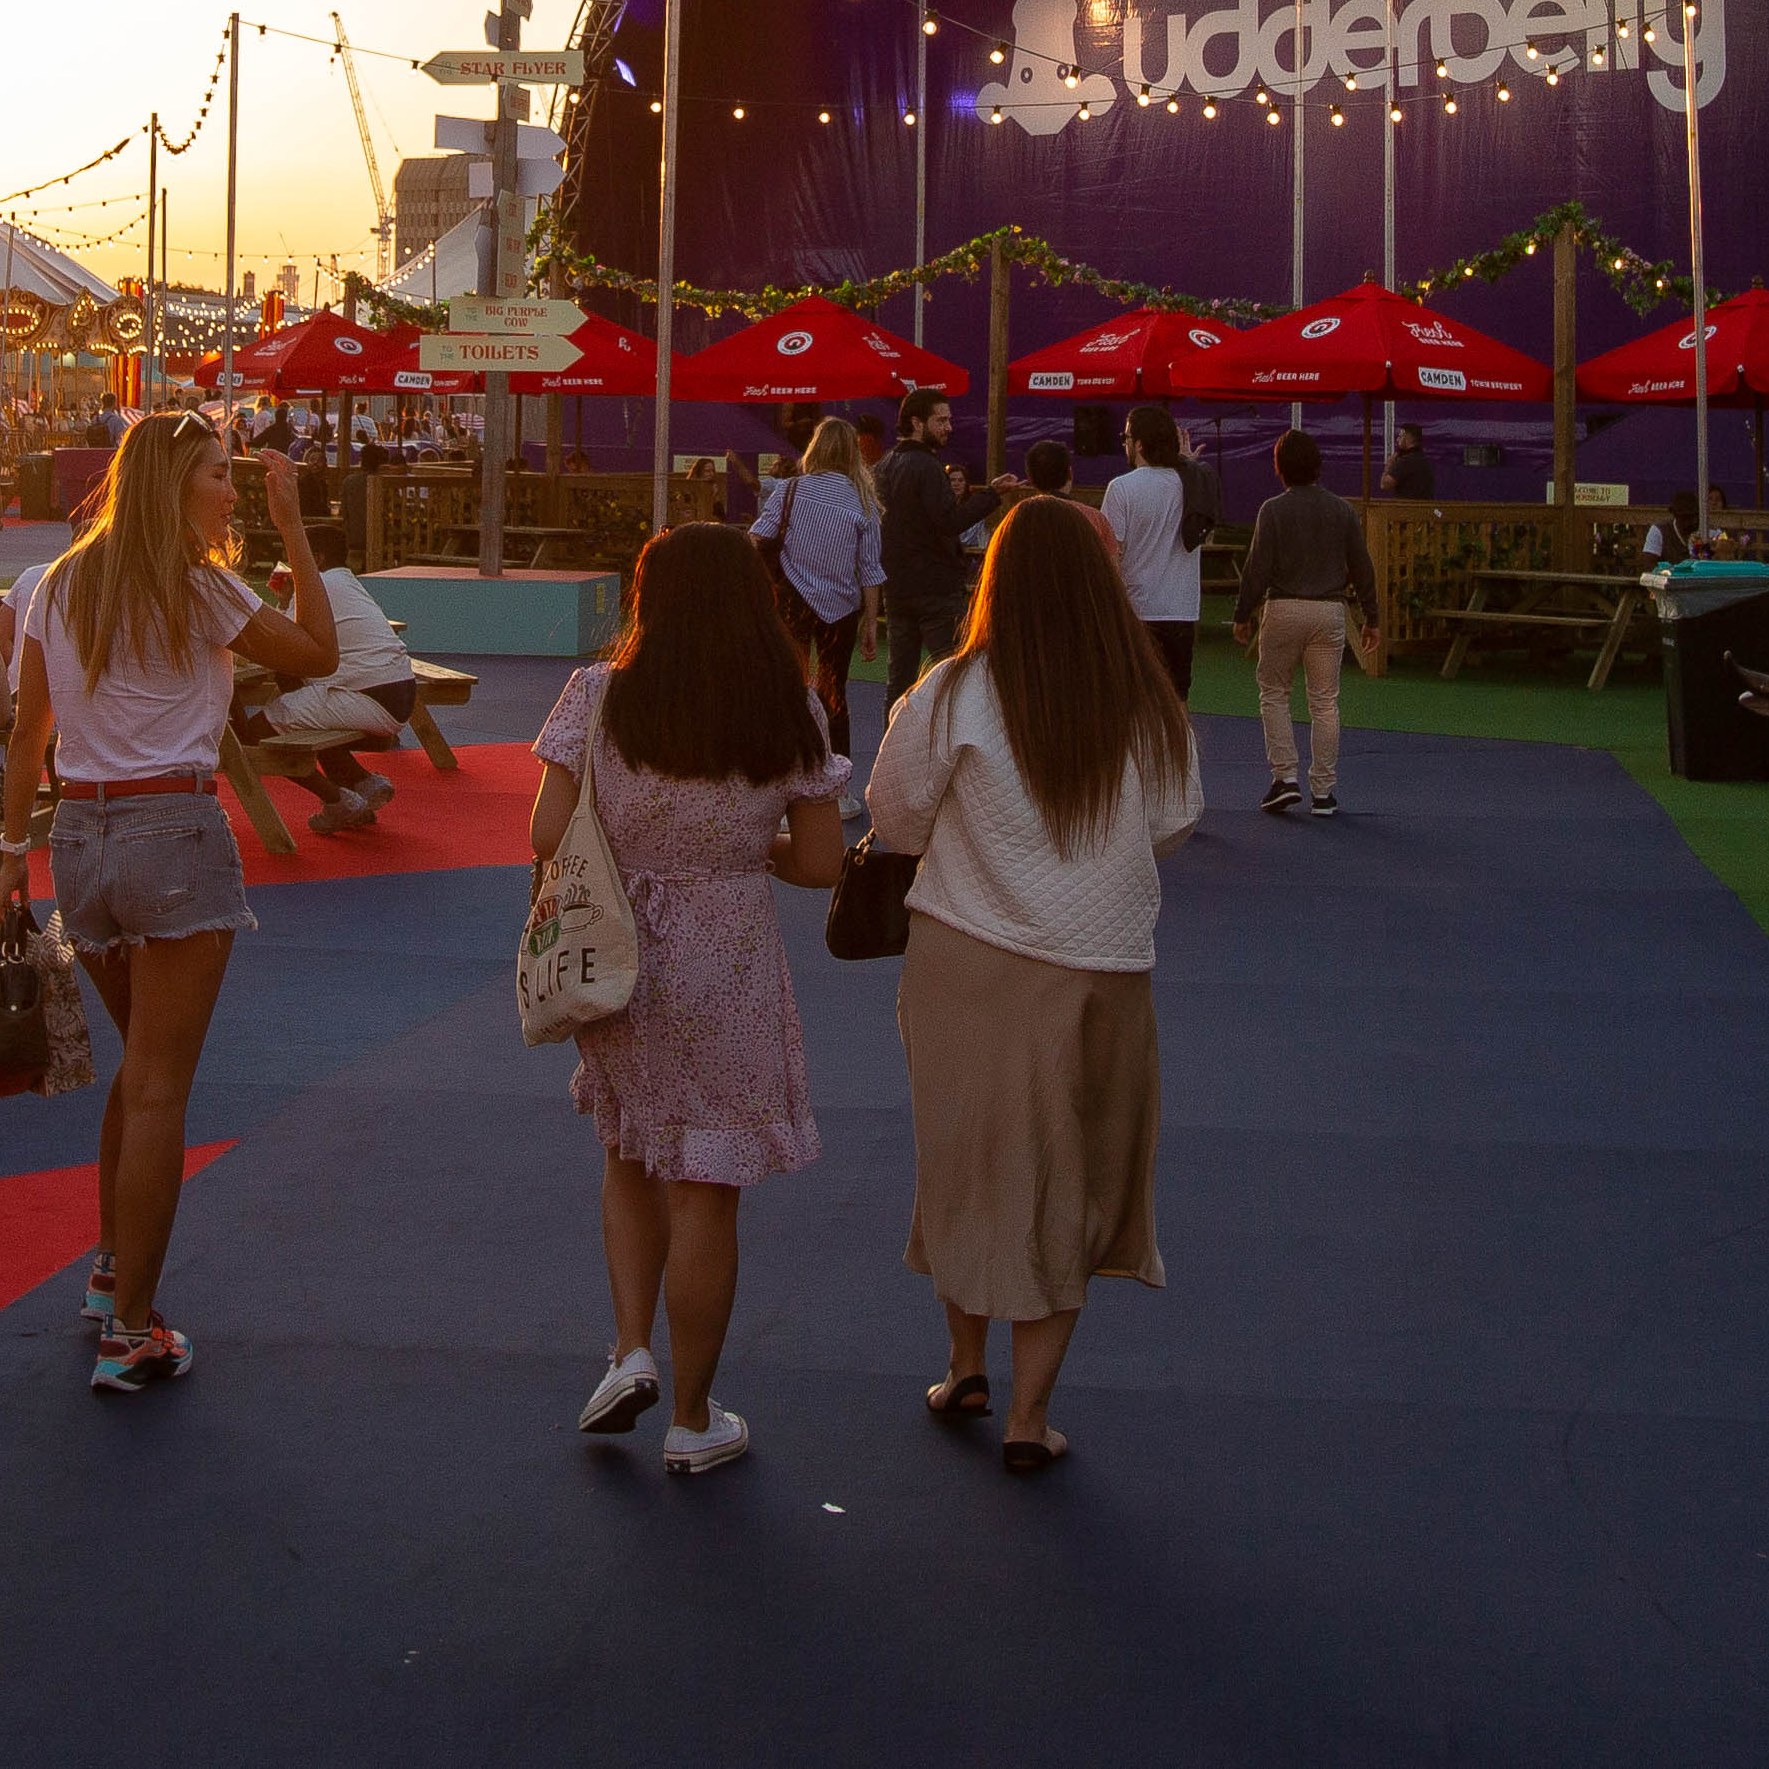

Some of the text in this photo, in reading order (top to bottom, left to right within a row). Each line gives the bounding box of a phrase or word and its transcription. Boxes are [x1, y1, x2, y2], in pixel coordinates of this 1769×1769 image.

[460, 61, 567, 76] STAR FLYER
[485, 305, 548, 318] BIG PURPLE
[504, 317, 528, 328] COW
[459, 344, 539, 361] TOILETS
[398, 374, 430, 385] CAMDEN
[1032, 376, 1070, 387] CAMDEN
[1420, 371, 1463, 386] CAMDEN
[535, 947, 597, 1004] LIFE
